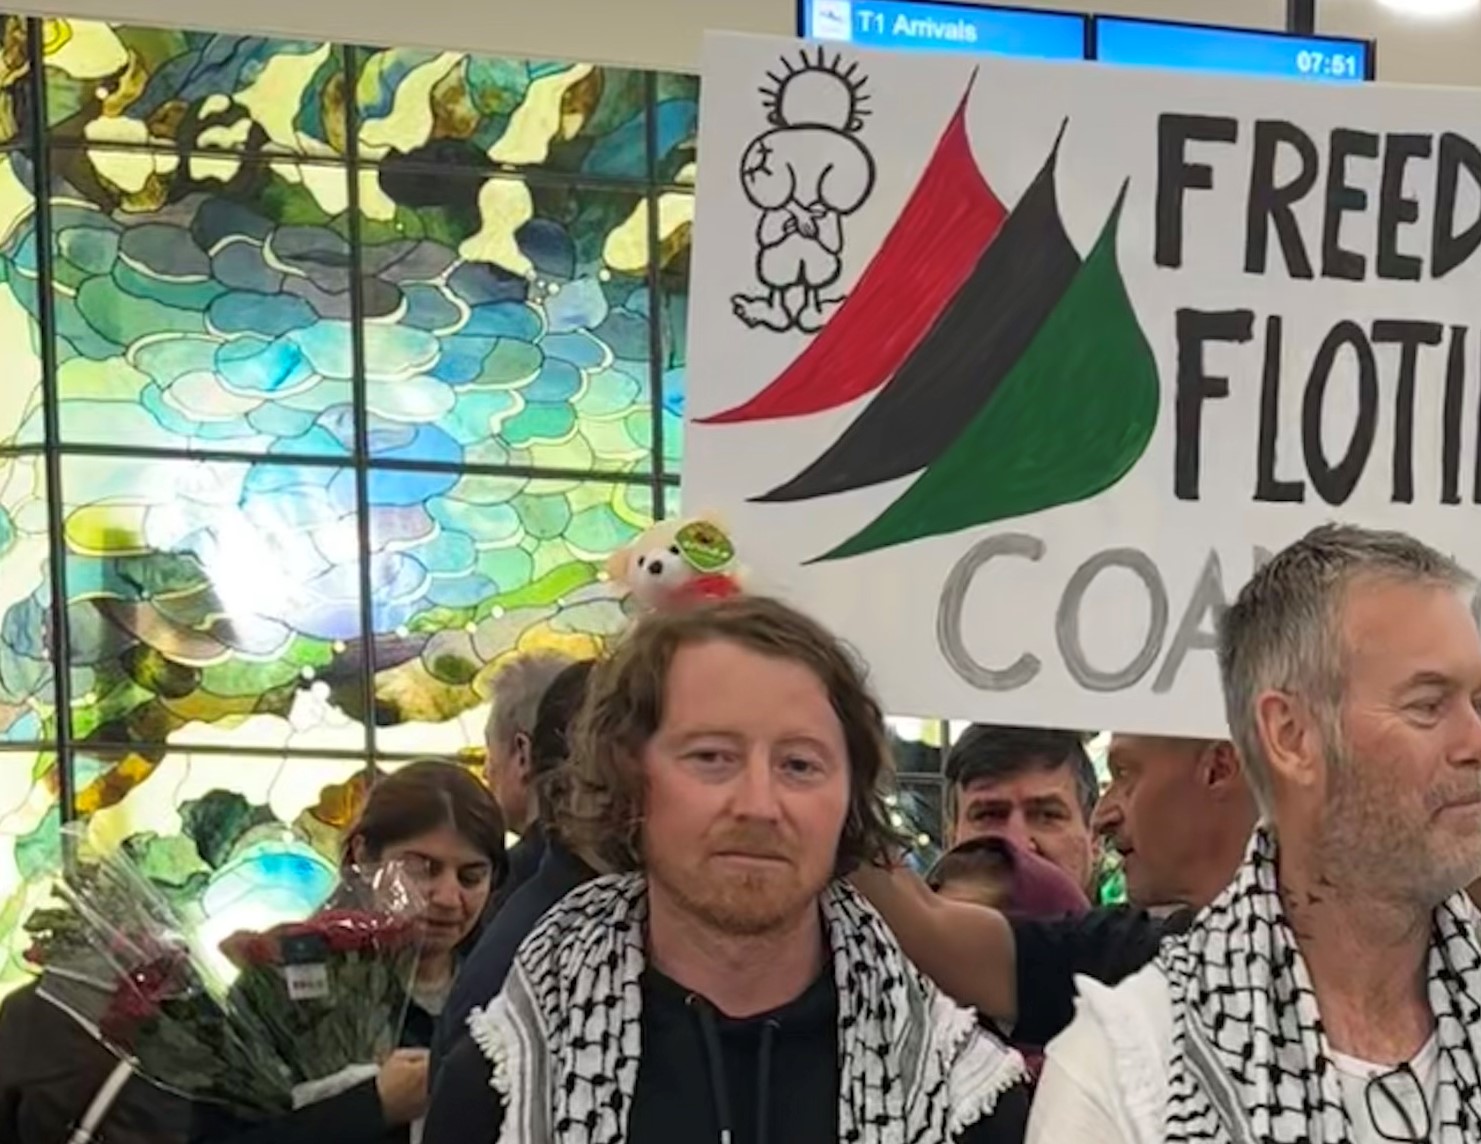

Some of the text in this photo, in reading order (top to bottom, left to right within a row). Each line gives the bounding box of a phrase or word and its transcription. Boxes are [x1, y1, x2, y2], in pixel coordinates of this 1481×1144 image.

[856, 10, 978, 43] T1 Arrivals
[1296, 49, 1356, 77] 07:51
